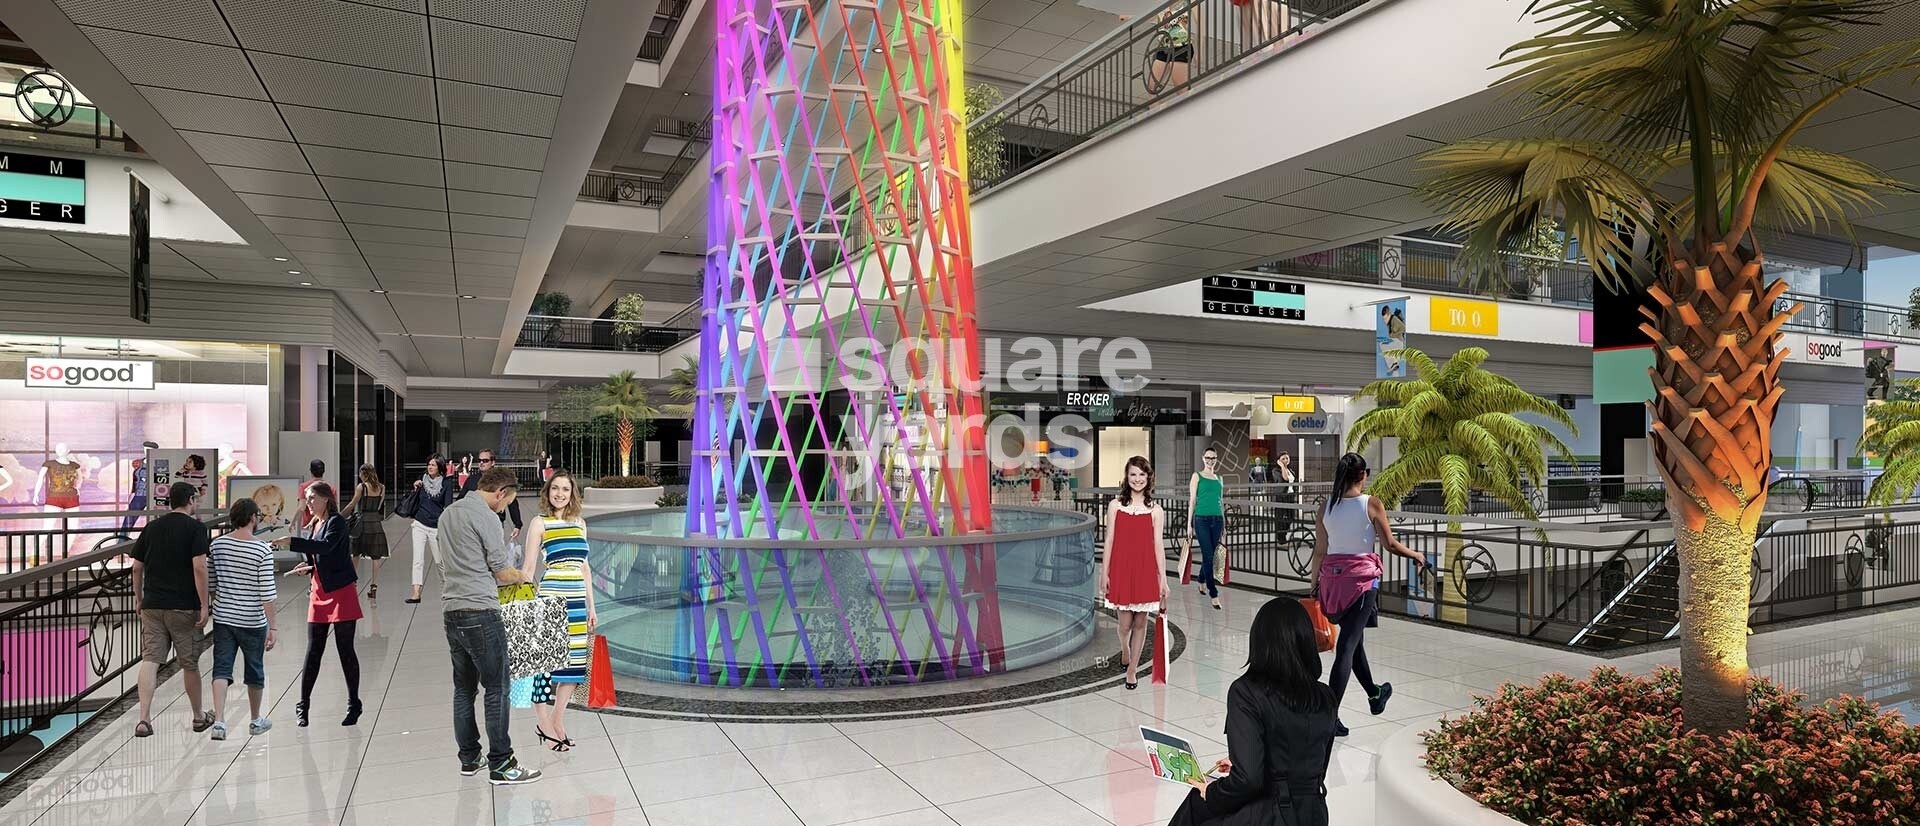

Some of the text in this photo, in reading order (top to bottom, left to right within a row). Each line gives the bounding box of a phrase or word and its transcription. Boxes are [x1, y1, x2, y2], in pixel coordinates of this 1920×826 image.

[1808, 341, 1841, 360] sogood
[30, 363, 133, 385] sogood
[1097, 401, 1159, 422] indoor lighting
[1291, 416, 1325, 429] clothes
